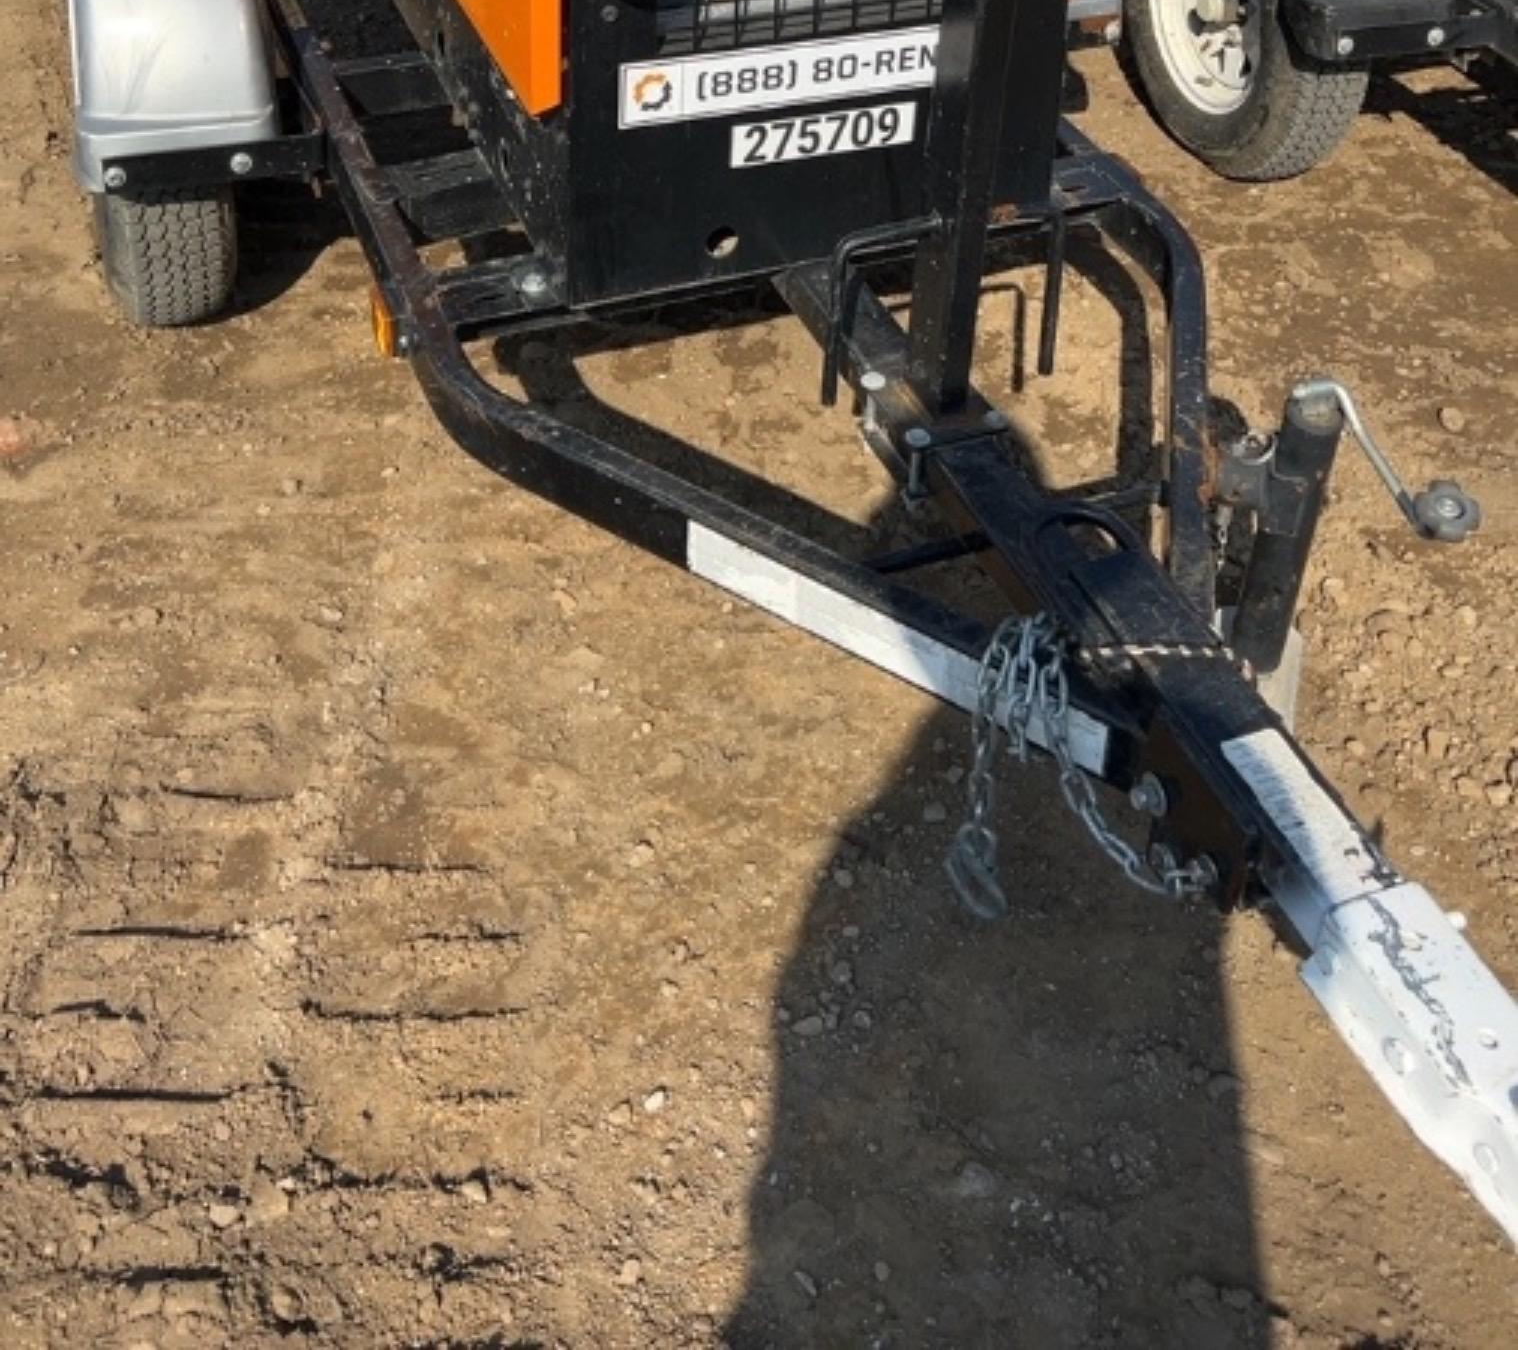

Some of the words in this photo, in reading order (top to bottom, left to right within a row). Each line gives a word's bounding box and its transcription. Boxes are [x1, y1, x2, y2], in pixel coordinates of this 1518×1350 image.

[697, 60, 798, 100] (888)
[812, 45, 937, 83] 80-REN
[743, 107, 899, 163] 275709
